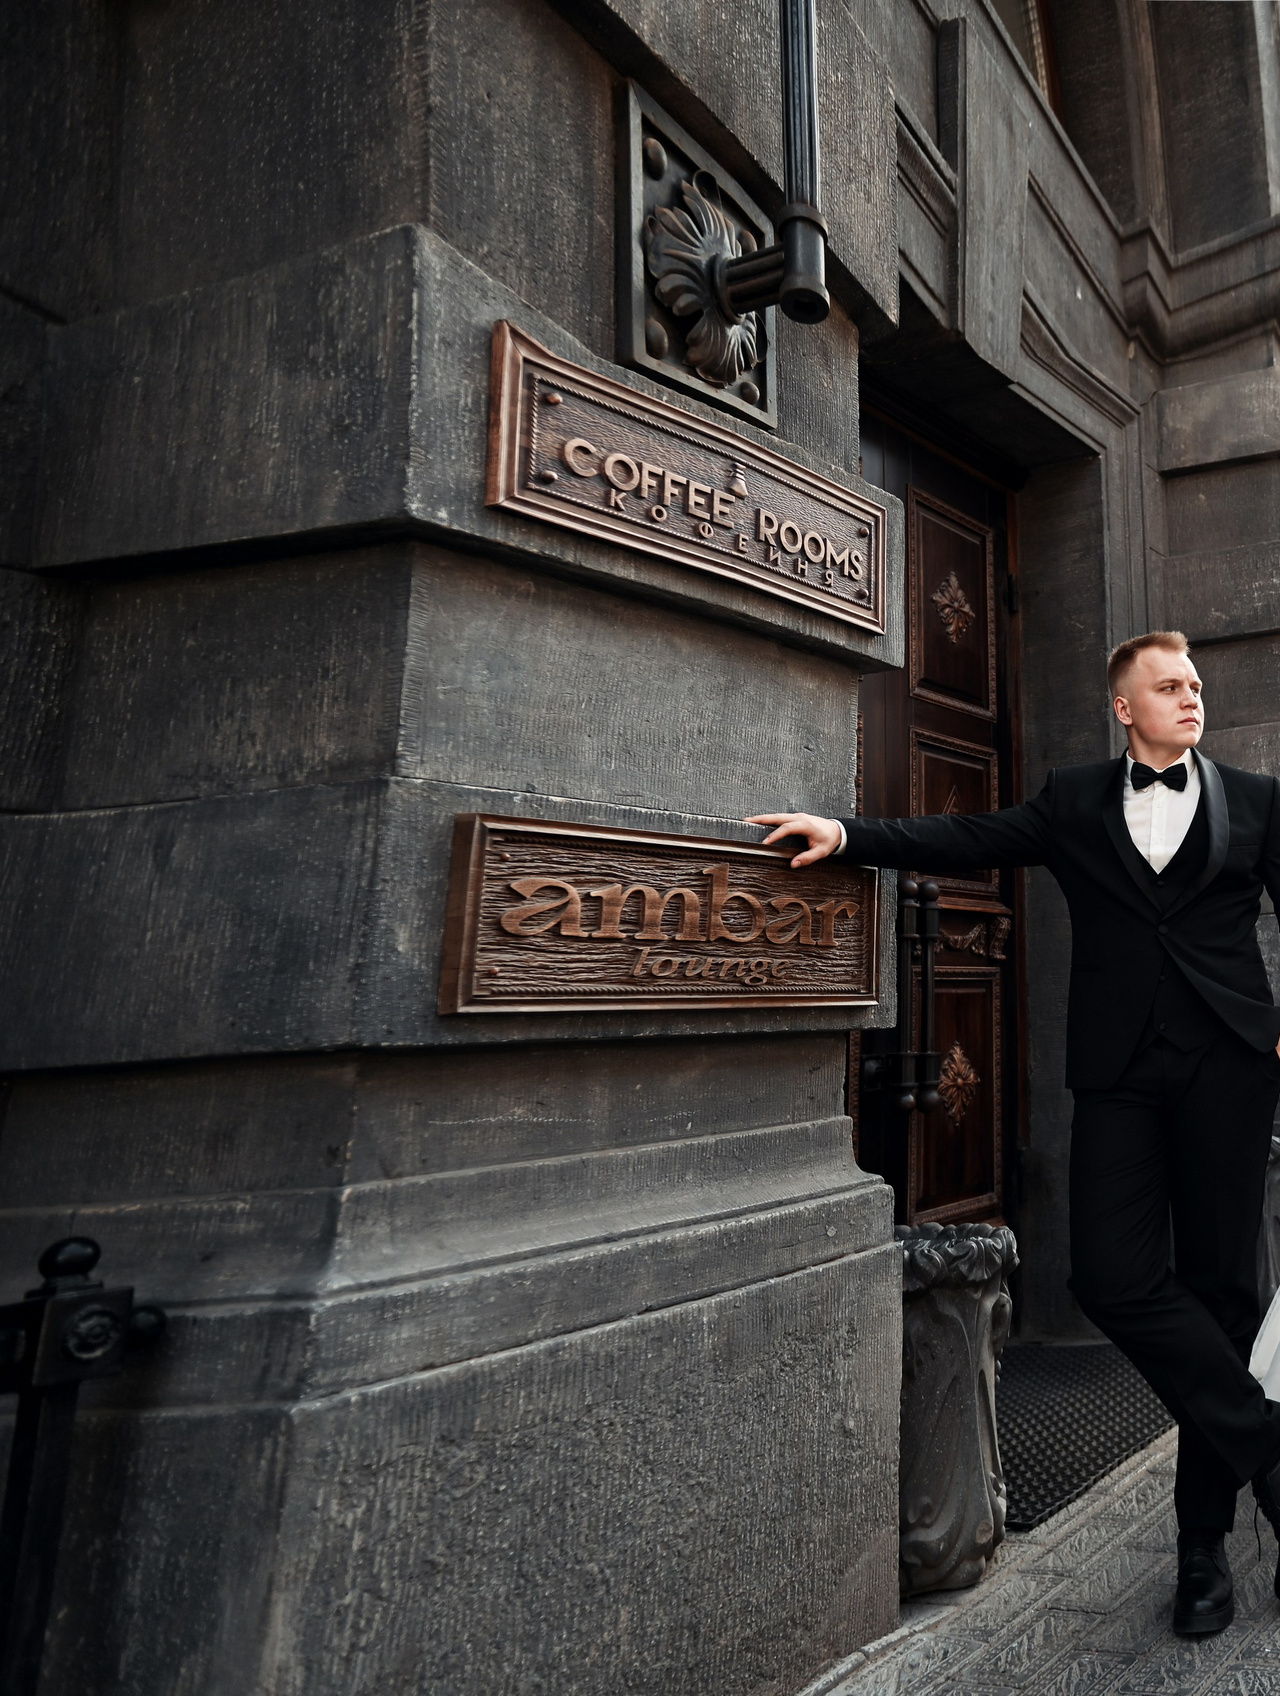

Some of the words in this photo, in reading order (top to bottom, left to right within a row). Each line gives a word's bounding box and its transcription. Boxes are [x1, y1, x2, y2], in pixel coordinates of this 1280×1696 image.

[565, 438, 735, 529] COFFEE
[757, 507, 863, 581] ROOMS
[500, 862, 861, 947] ambar
[632, 946, 790, 986] lounge
